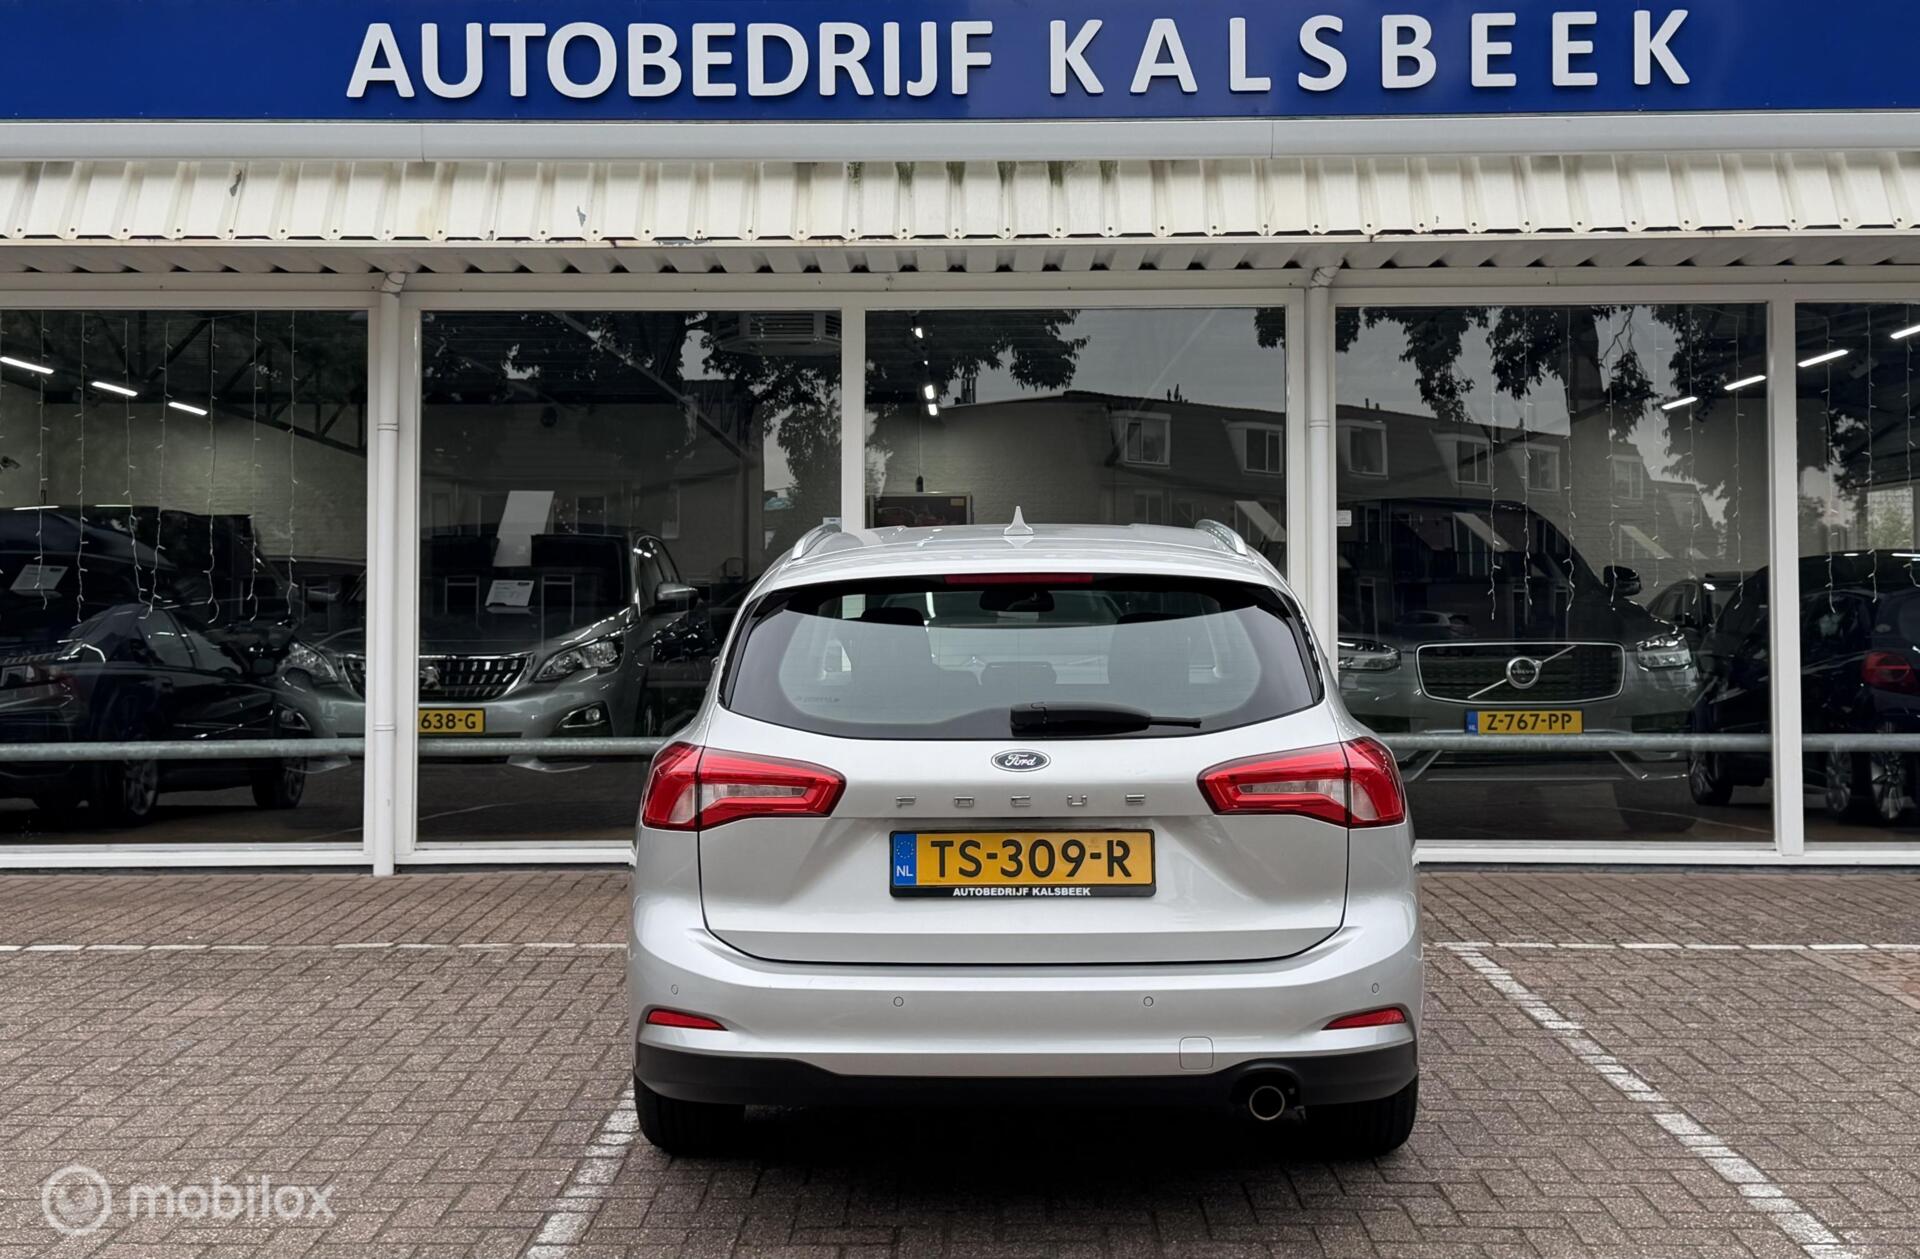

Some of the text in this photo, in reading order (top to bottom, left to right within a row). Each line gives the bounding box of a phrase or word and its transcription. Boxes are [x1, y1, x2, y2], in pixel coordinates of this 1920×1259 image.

[346, 9, 1690, 98] AUTOBEDRIJF KALSBEEK
[421, 713, 476, 729] 638-G
[1487, 714, 1572, 731] Z-767-PP
[1005, 754, 1037, 766] Ford
[896, 839, 1132, 878] NL TS-309-R
[953, 887, 1091, 897] AUTOBEDRIJF KALSBEEK
